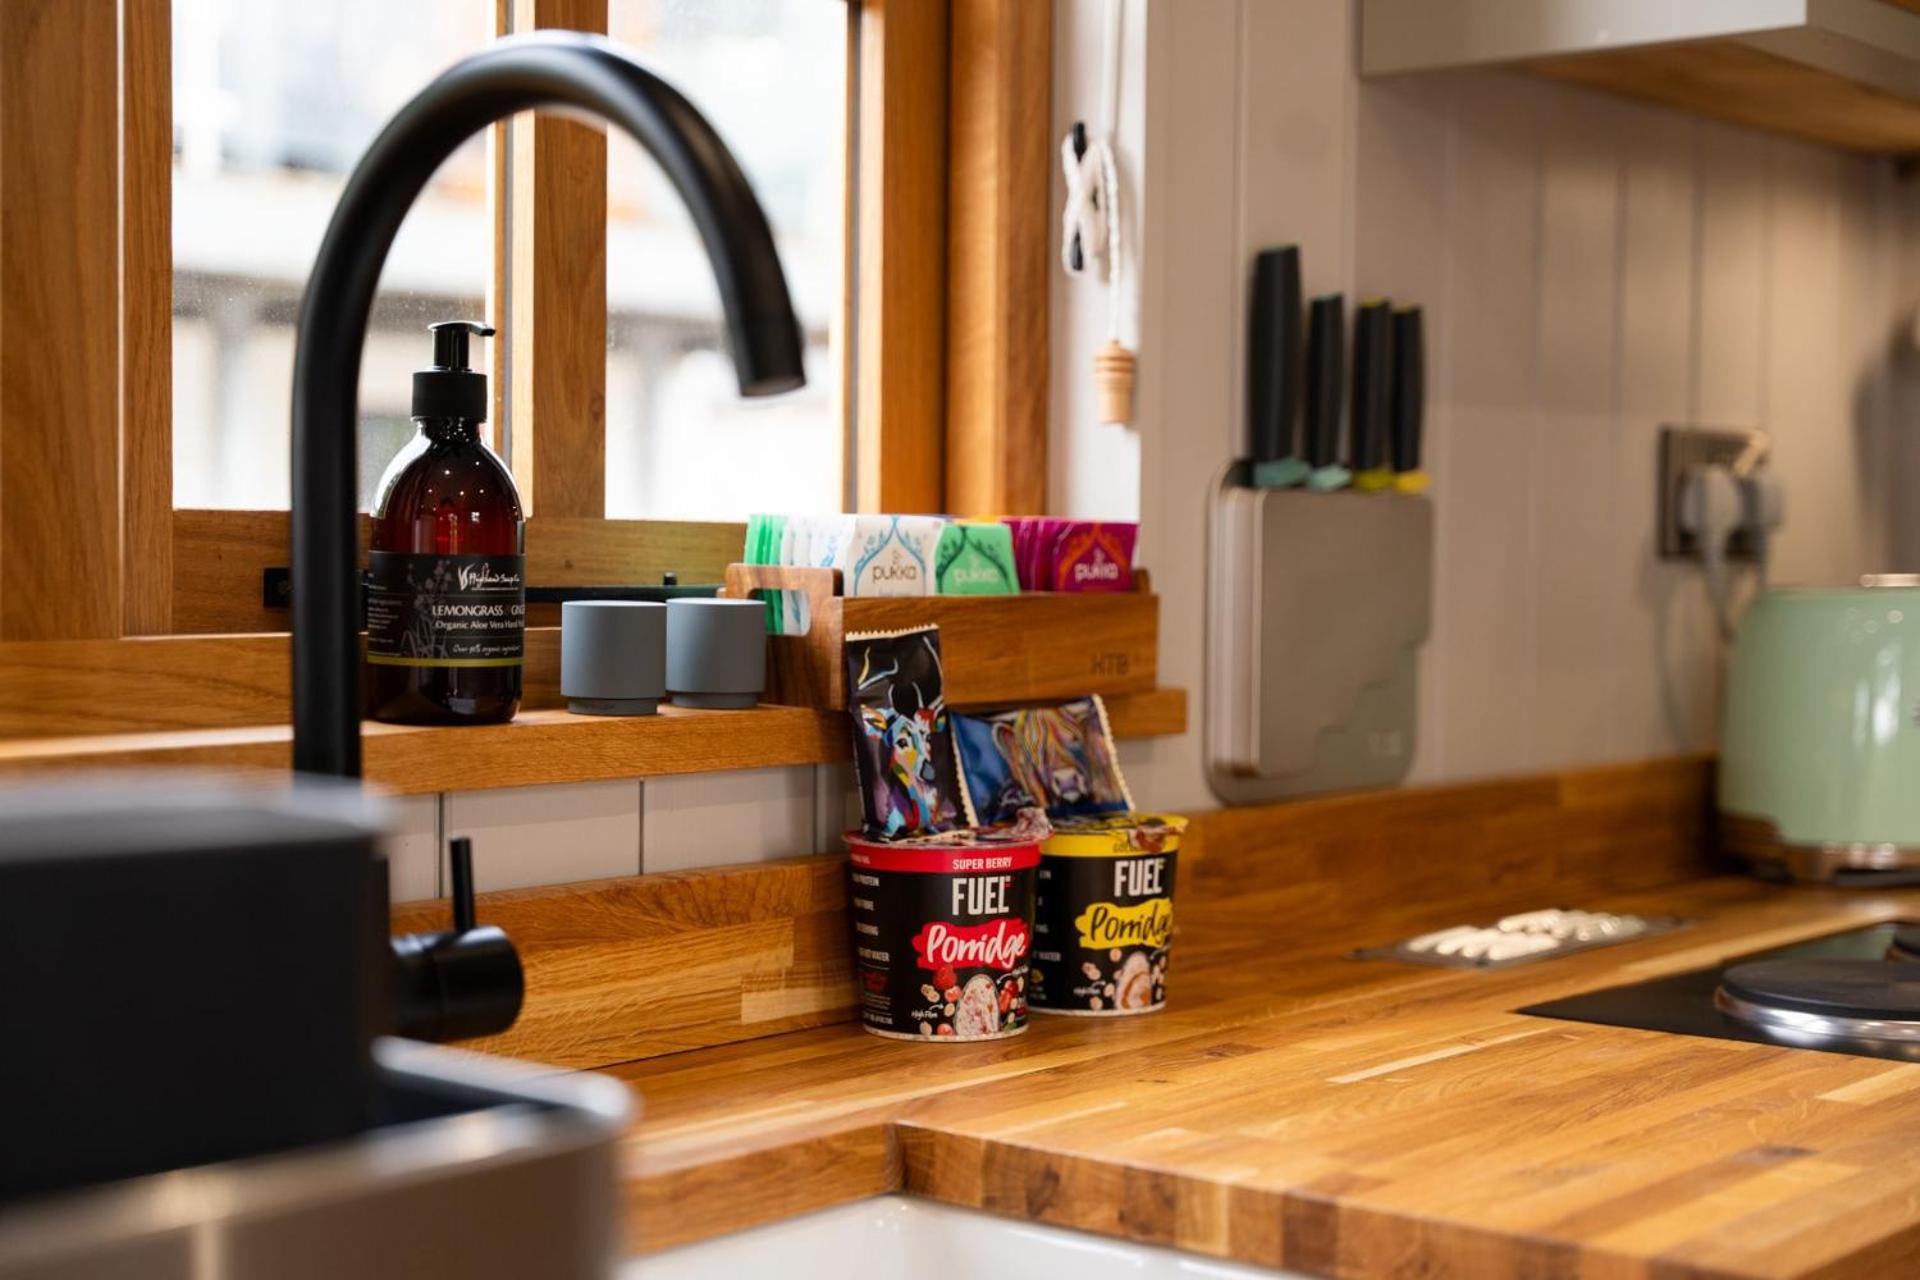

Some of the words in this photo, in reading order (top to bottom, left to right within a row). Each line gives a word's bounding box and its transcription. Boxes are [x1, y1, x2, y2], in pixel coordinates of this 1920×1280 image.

[872, 564, 916, 584] pukka
[953, 567, 999, 585] pukka
[1074, 561, 1120, 581] pukka
[432, 604, 503, 616] LEMONGRASS
[435, 619, 469, 631] Organic
[470, 619, 488, 629] Aloe
[952, 858, 984, 871] SUPER
[985, 856, 1013, 869] BERRY
[926, 920, 1027, 968] Porridge
